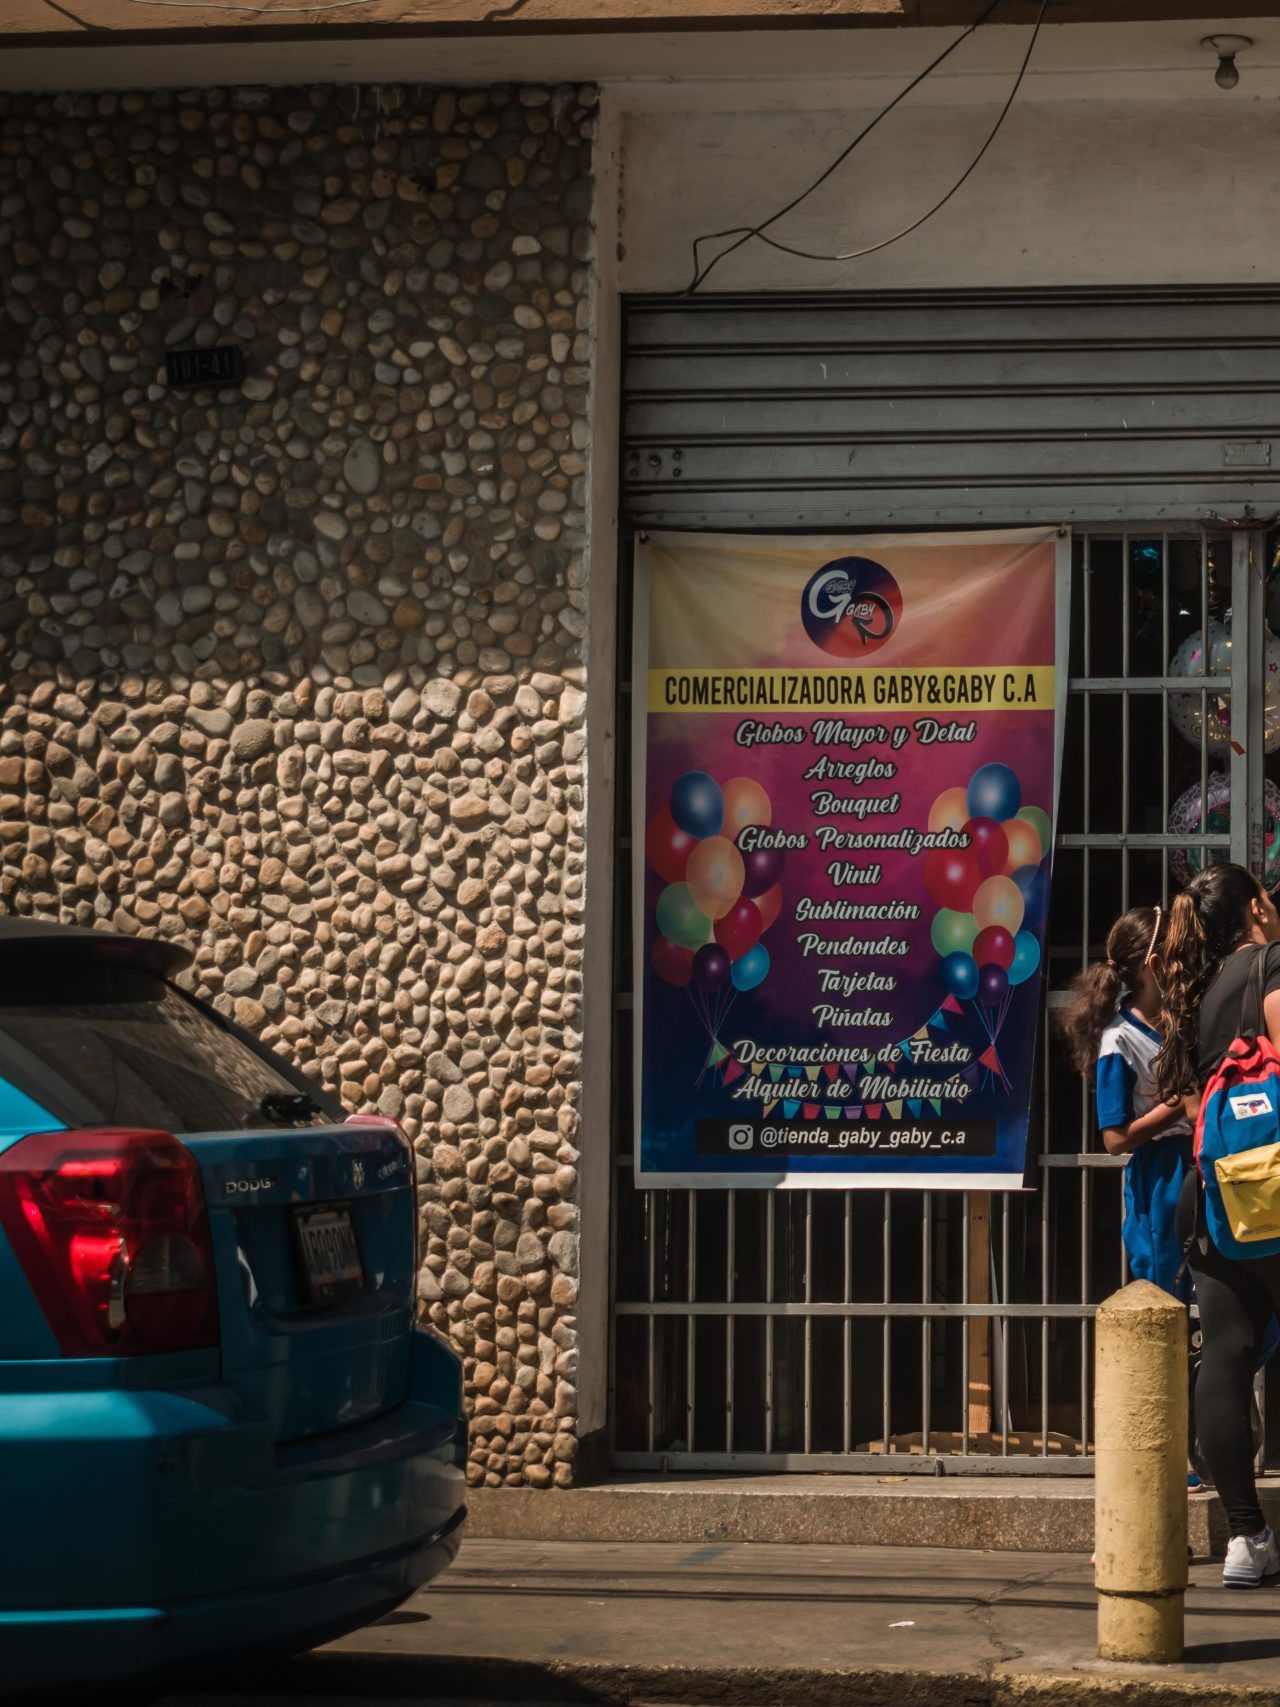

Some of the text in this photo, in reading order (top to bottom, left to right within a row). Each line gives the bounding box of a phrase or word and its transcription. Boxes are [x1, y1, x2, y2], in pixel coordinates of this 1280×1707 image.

[846, 603, 875, 616] GABY
[665, 673, 1037, 705] COMERCIALIZADORA GABY&GABY C.A
[735, 719, 976, 749] Globos Mayor y Detal
[804, 755, 896, 783] Arreglos
[810, 791, 900, 817] Bouquet
[737, 824, 971, 853] Globos Personalizados
[827, 860, 881, 886] Vinil
[795, 897, 920, 922] Sublimación
[797, 932, 910, 957] Pendondes
[817, 968, 896, 997] Tarjetas
[812, 1004, 894, 1028] Piñatas
[732, 1039, 972, 1065] Decoraciones de Fiesta
[732, 1076, 972, 1104] Alquiler de Mobiliario
[760, 1126, 966, 1150] @tienda_gaby_gaby_c.a
[225, 1176, 274, 1194] DODG
